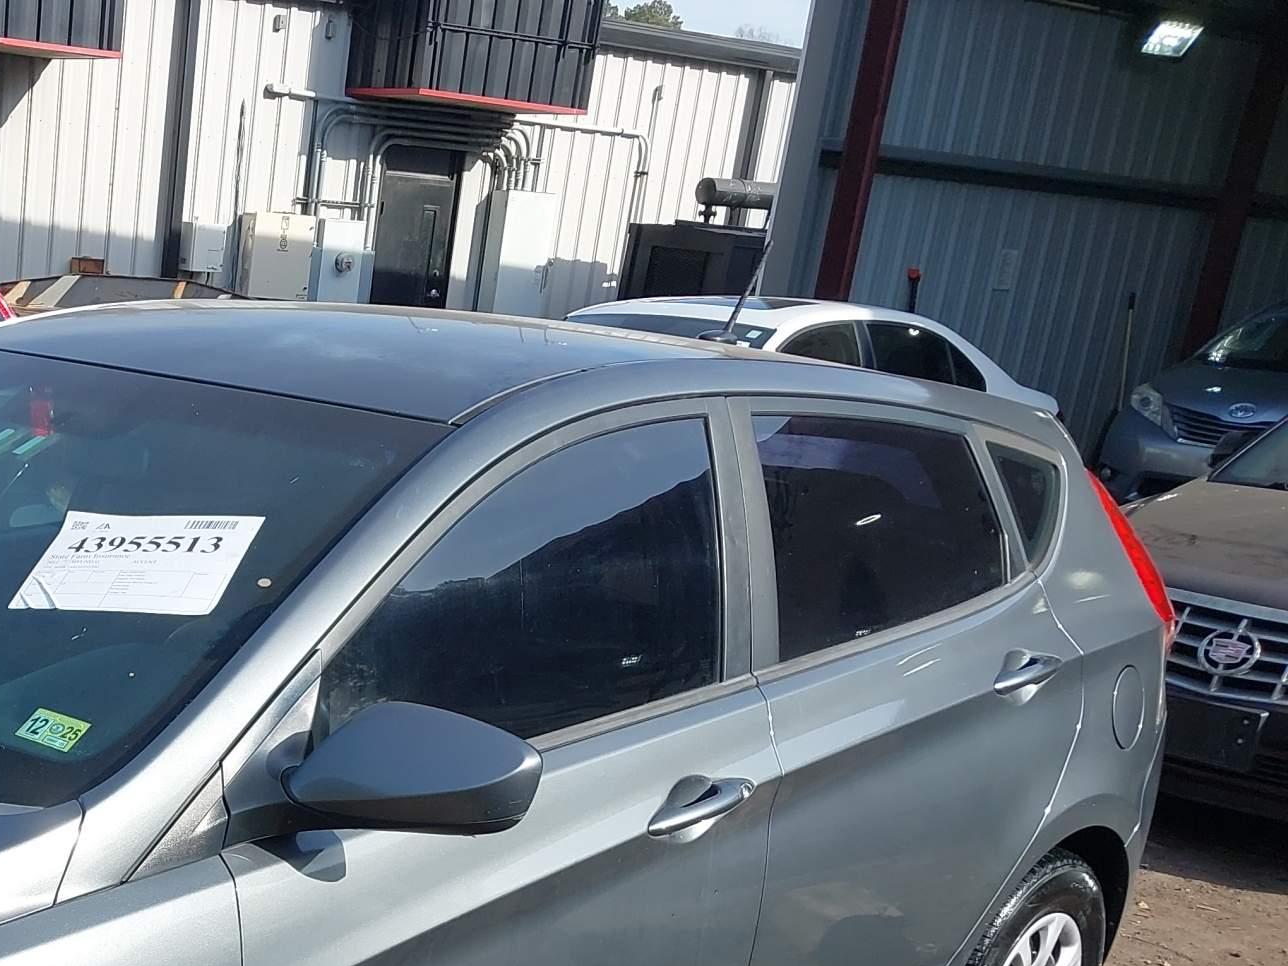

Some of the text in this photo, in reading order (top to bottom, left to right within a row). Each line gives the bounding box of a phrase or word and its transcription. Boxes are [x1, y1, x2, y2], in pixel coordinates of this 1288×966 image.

[67, 536, 224, 554] 43955513
[26, 716, 82, 741] 12 25
